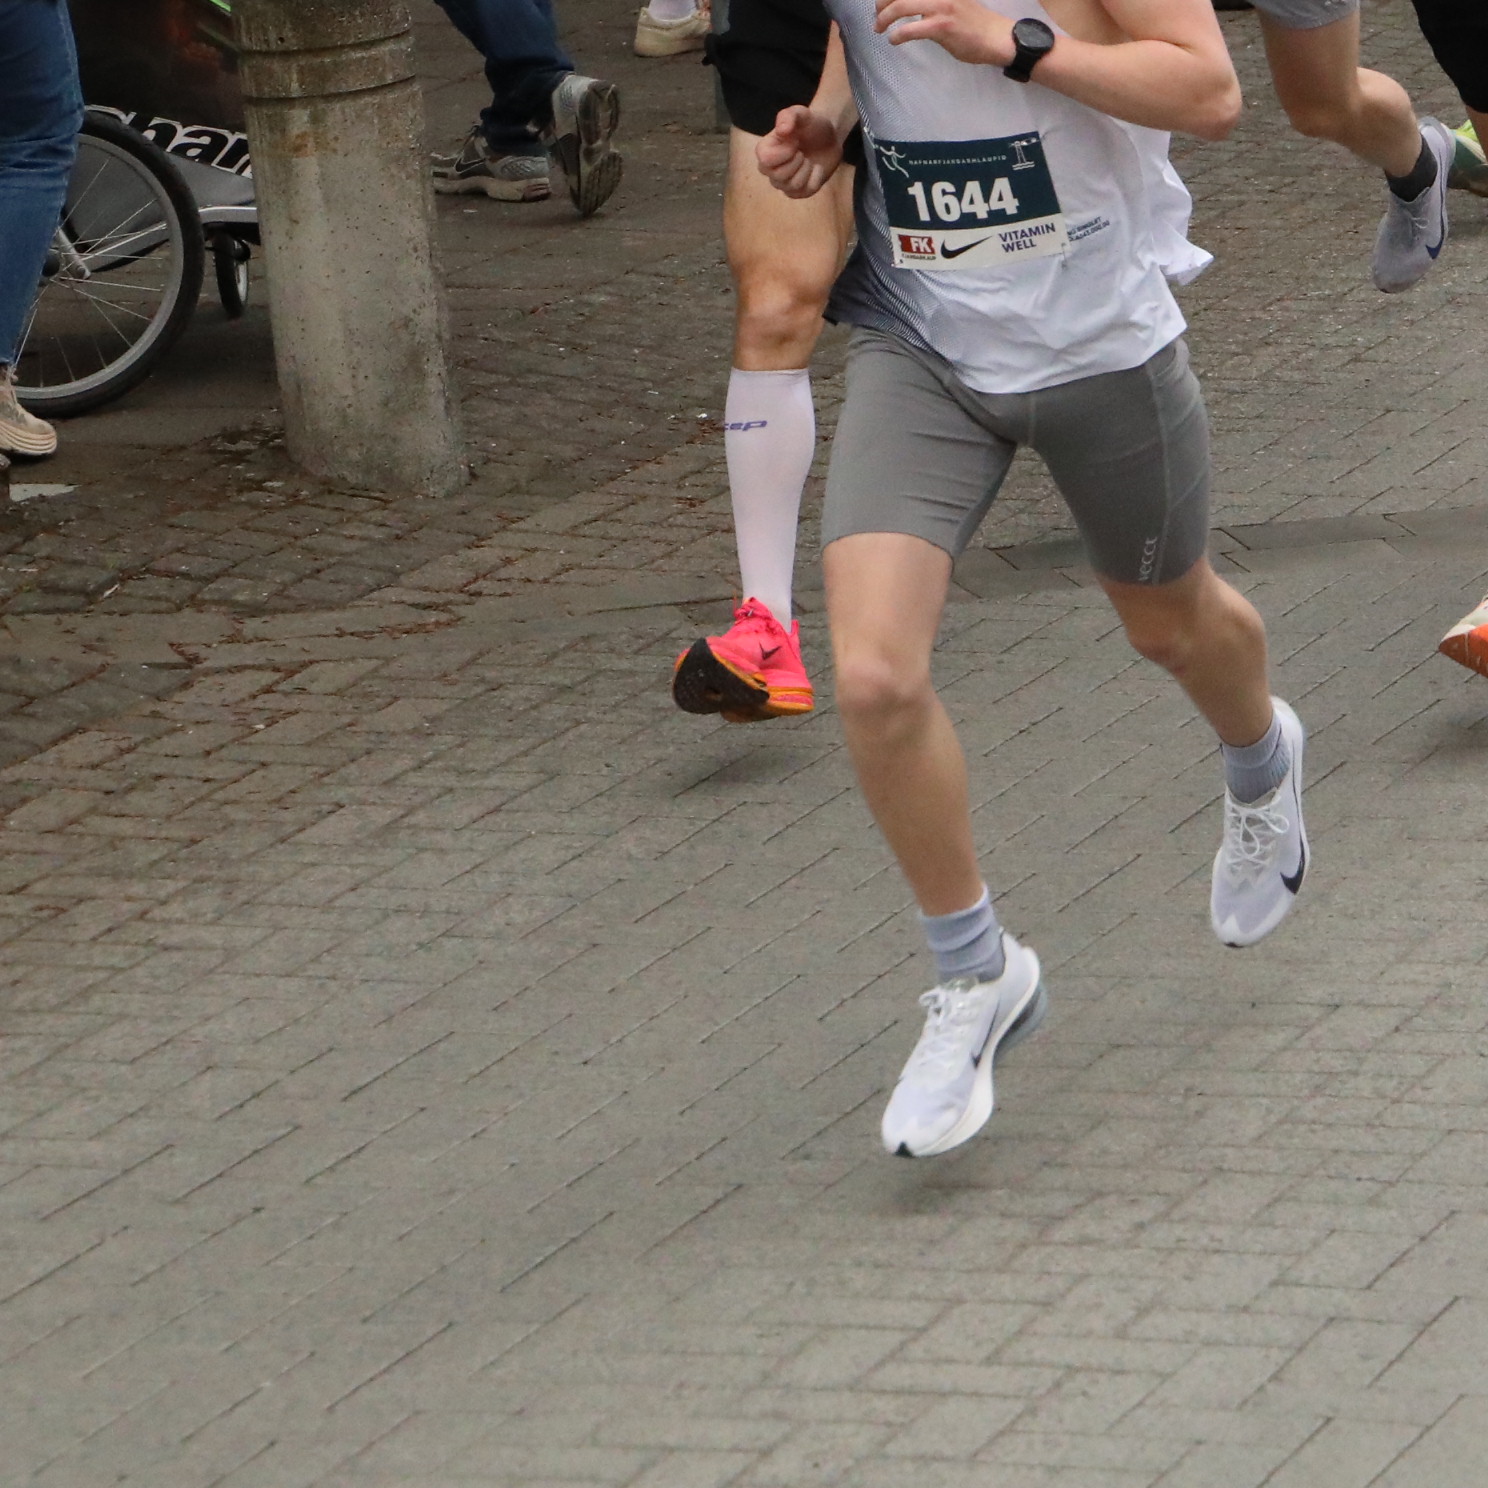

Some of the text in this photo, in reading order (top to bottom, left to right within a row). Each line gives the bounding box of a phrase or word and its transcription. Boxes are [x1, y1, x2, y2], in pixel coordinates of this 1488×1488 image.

[907, 176, 1020, 222] 1644
[998, 222, 1057, 243] VITAMIN
[1001, 238, 1037, 254] WELL
